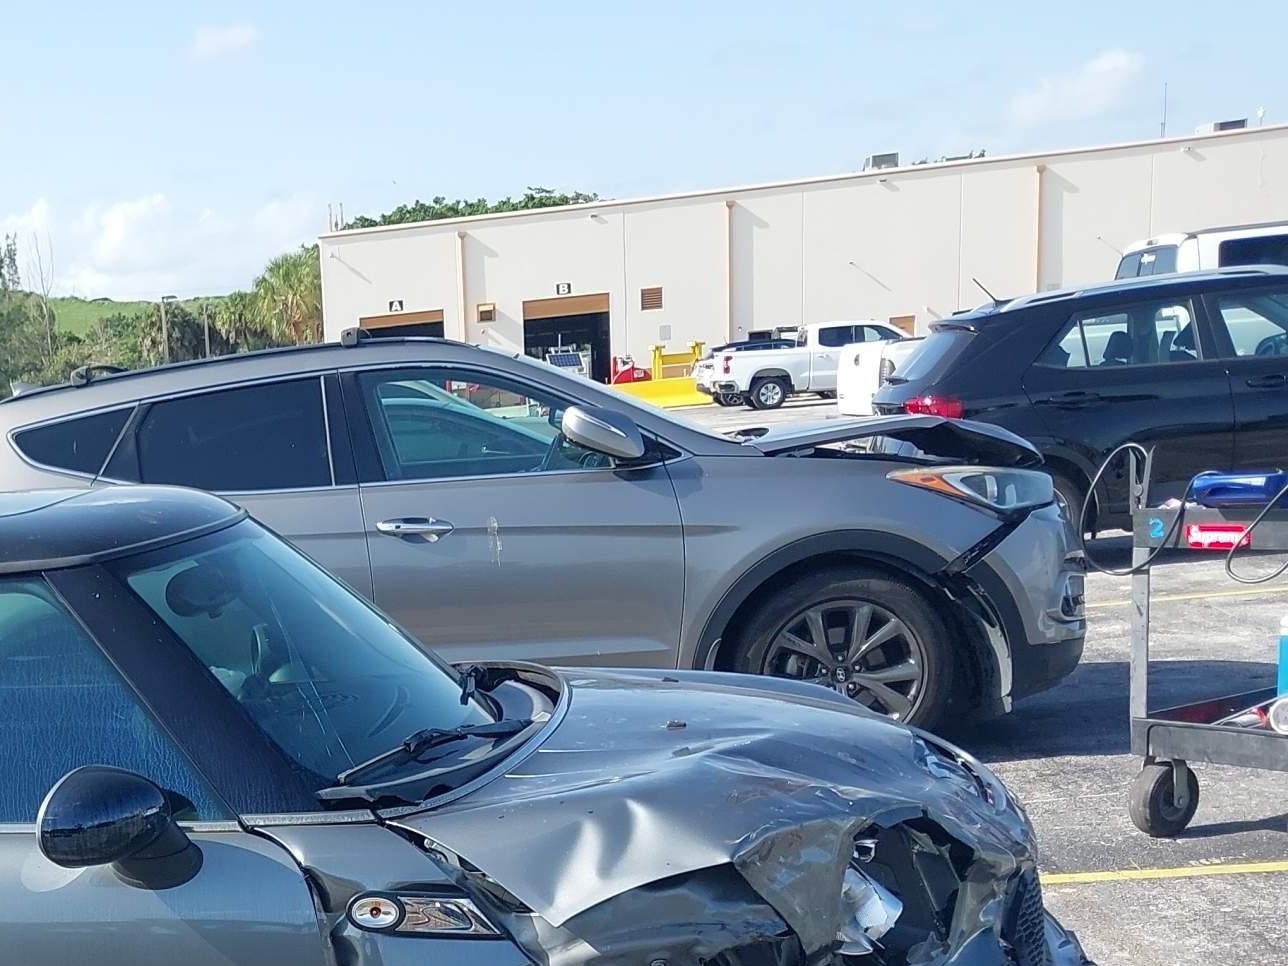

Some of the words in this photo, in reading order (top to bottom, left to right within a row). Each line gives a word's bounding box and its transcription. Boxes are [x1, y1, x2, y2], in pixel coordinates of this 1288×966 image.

[558, 283, 569, 295] B
[391, 300, 402, 312] A
[1149, 518, 1164, 538] 2
